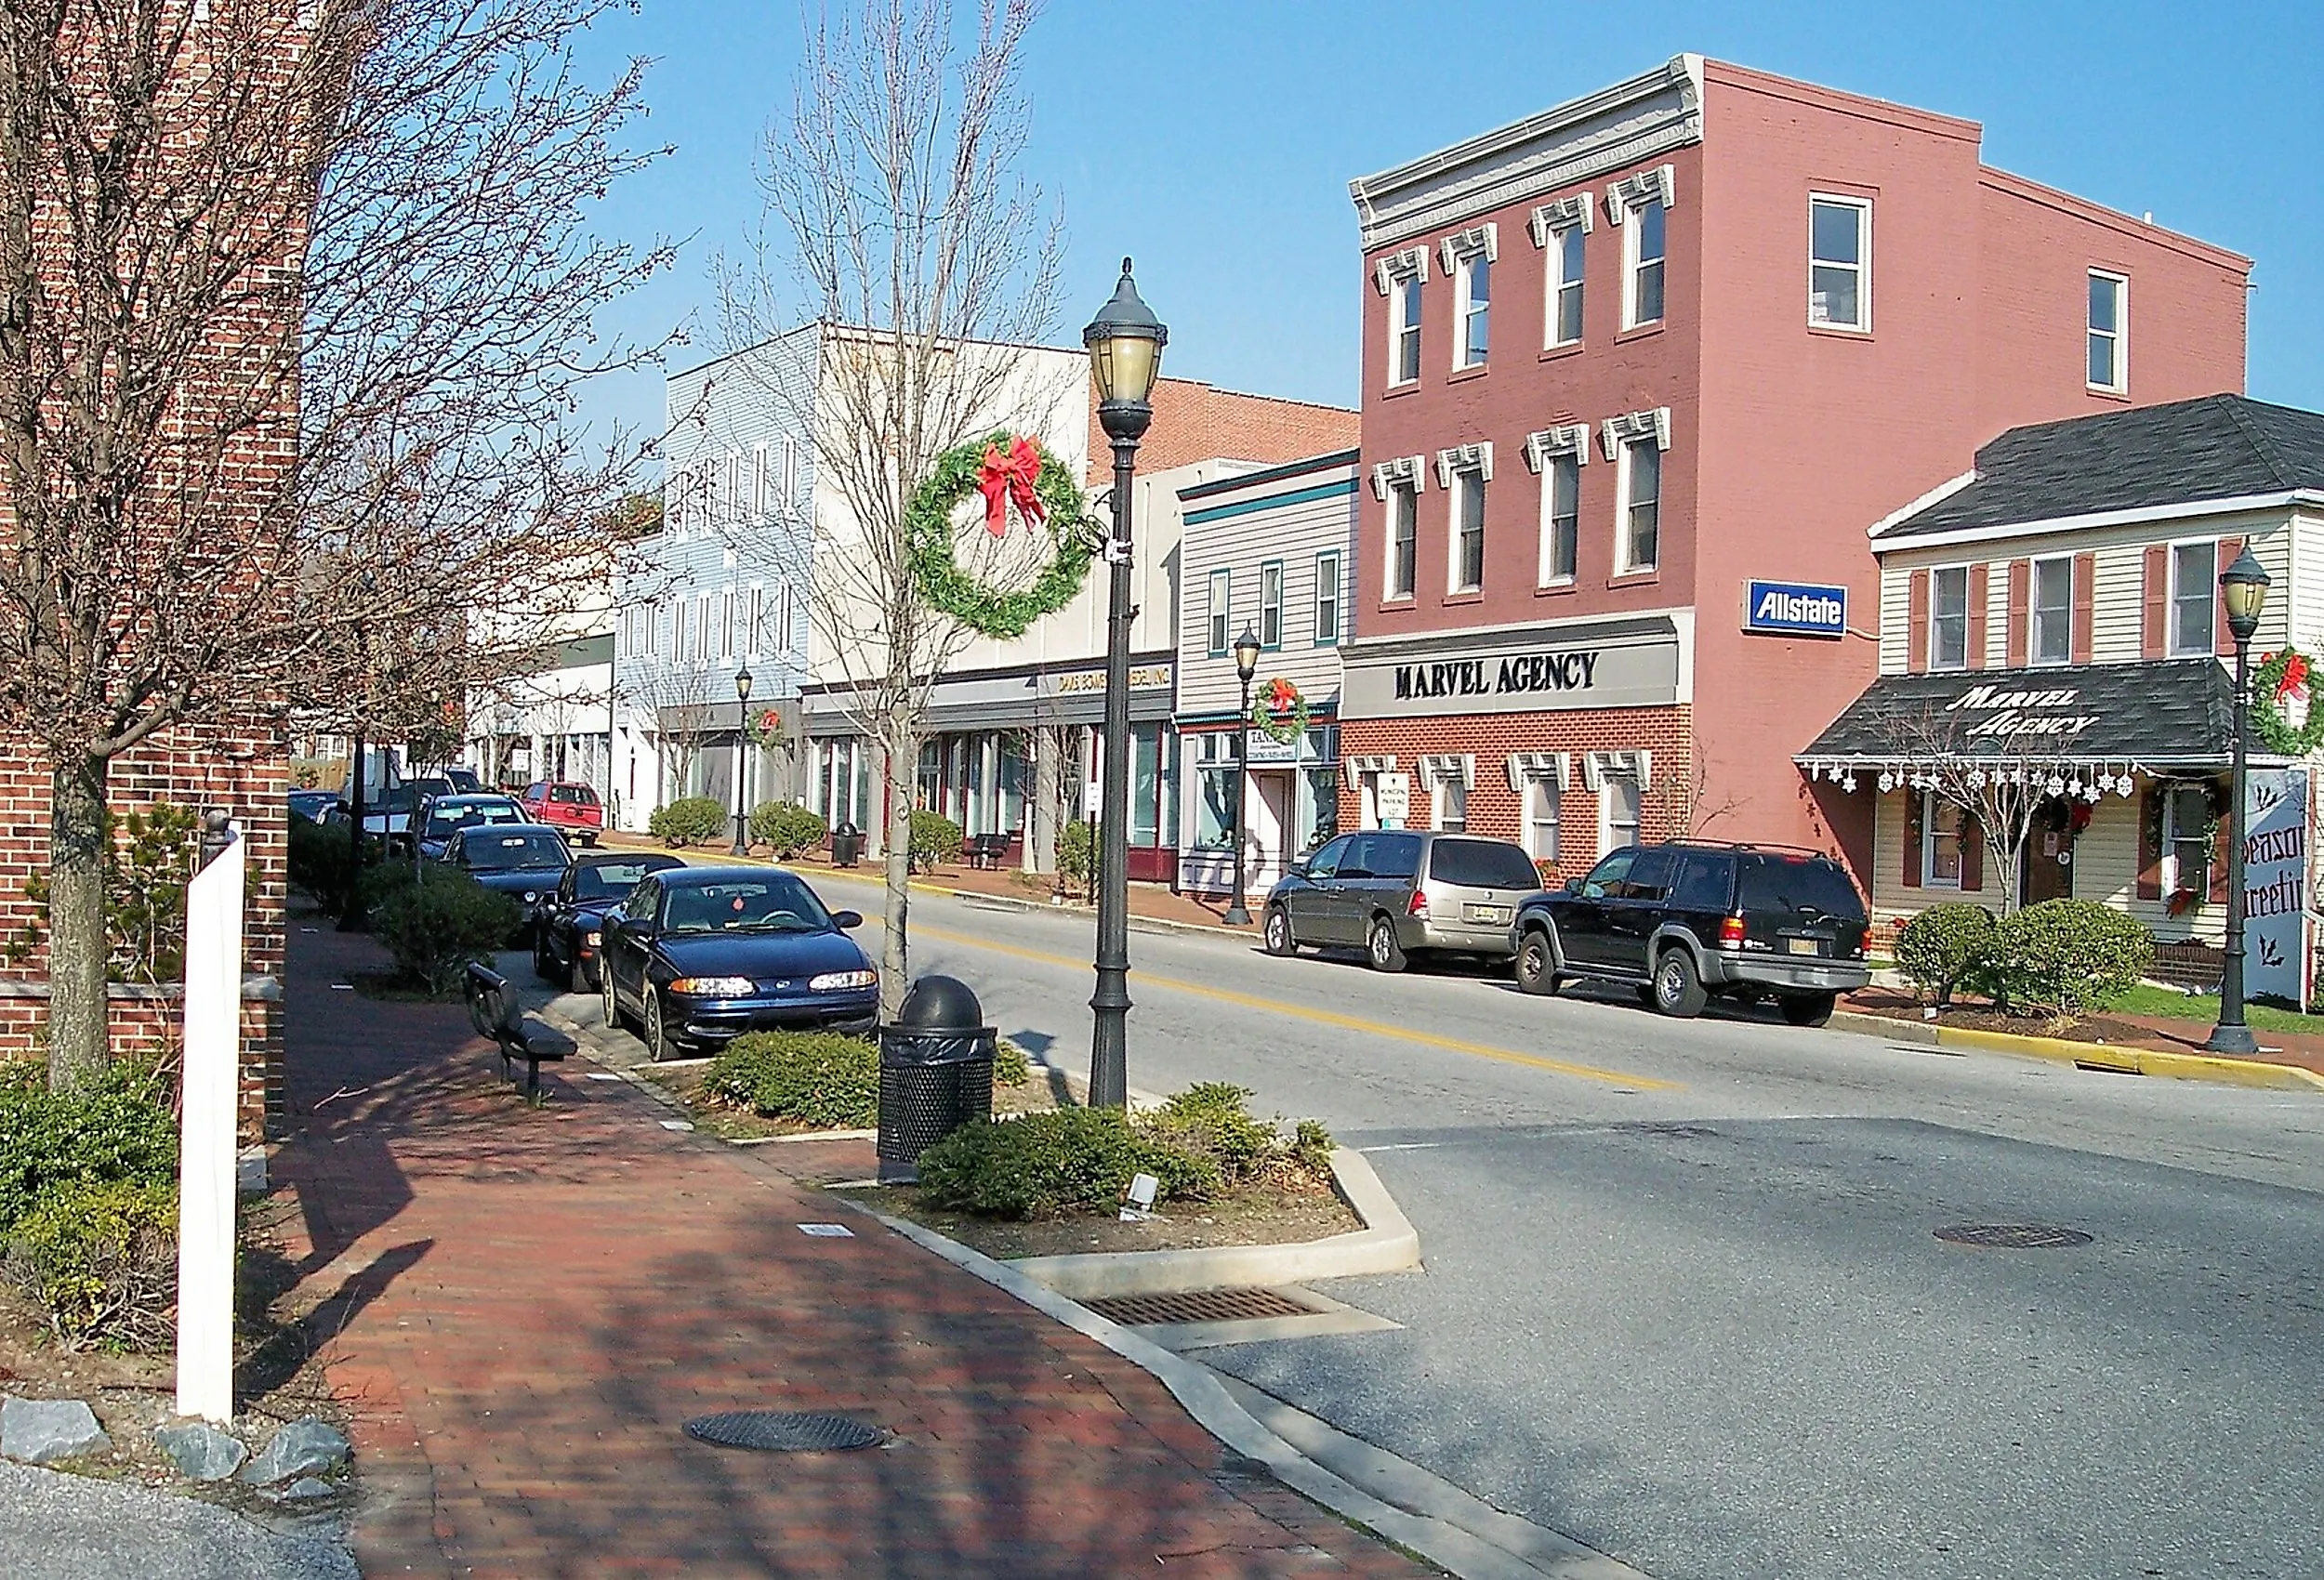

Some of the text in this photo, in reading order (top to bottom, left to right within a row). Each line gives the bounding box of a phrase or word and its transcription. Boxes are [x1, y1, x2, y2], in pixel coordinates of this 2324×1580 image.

[1755, 591, 1842, 625] Allstate
[1394, 652, 1600, 701] MARVEL AGENCY
[1964, 708, 2102, 736] AGENCY
